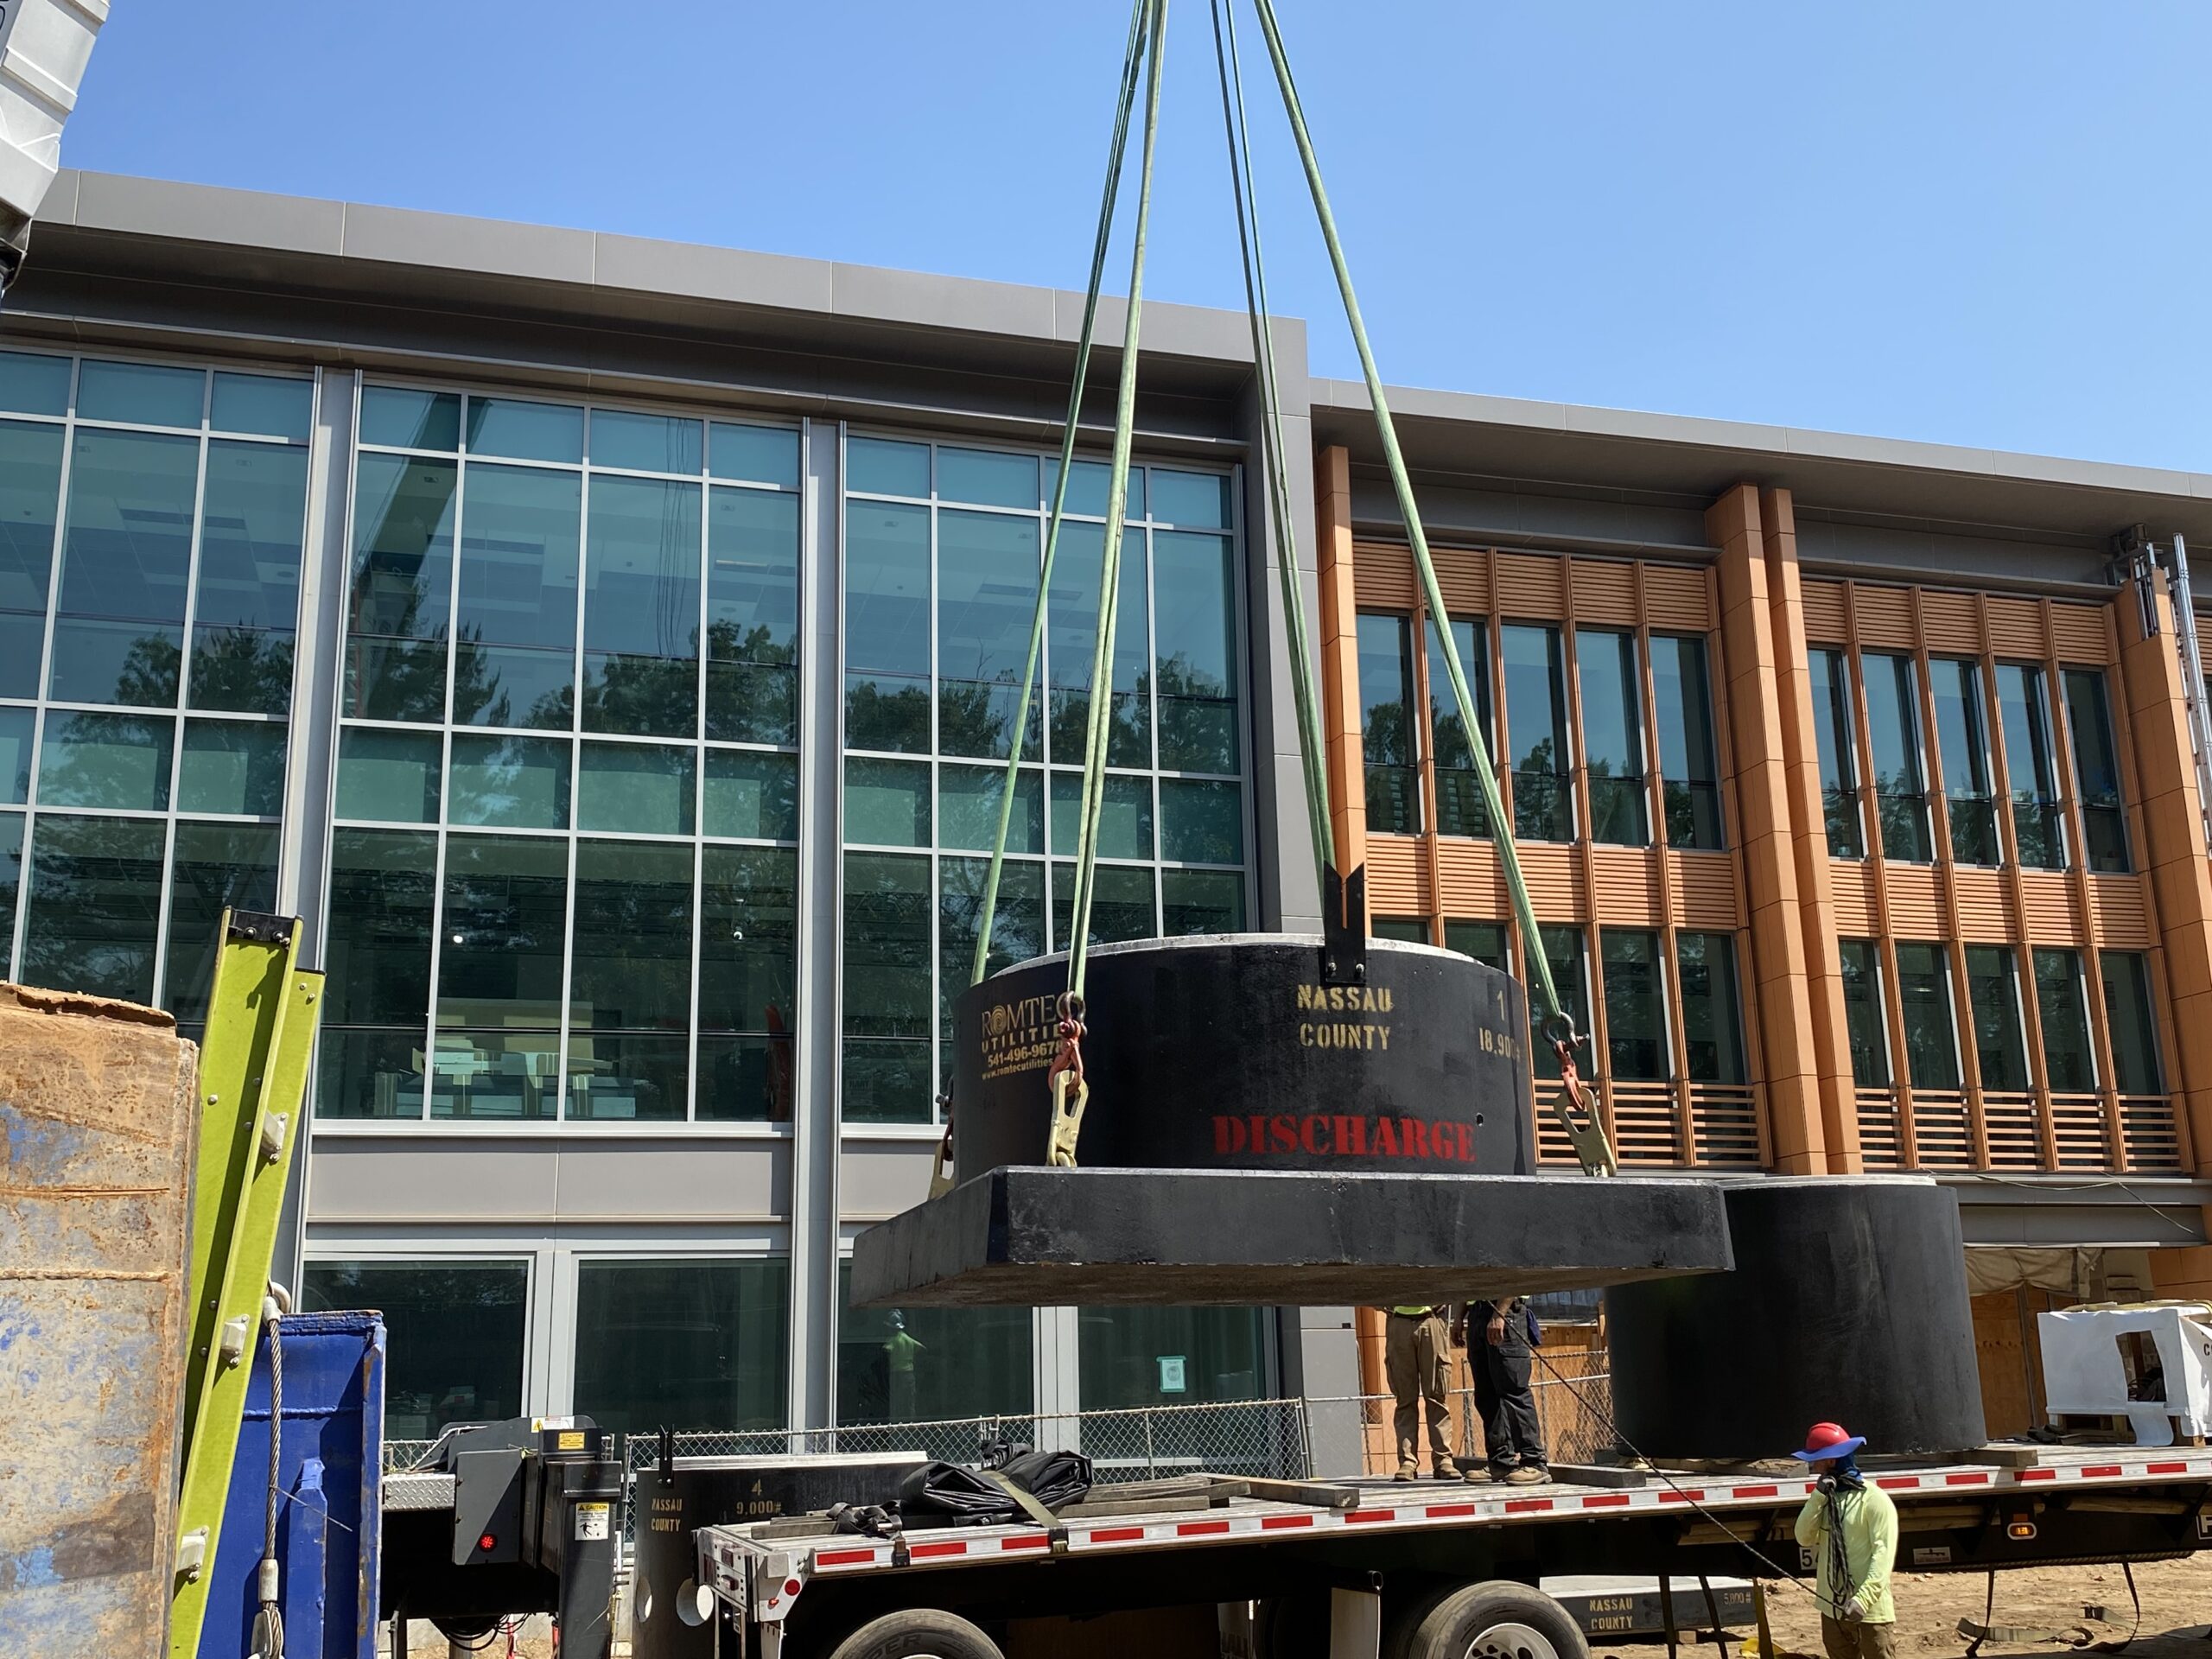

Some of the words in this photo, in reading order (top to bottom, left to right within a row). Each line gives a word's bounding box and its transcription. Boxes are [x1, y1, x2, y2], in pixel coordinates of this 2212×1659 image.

[1297, 984, 1393, 1012] NASSAU
[1497, 990, 1504, 1021] 1
[982, 995, 1057, 1038] ROMTE
[982, 1023, 1062, 1052] UTILITIE
[1300, 1022, 1391, 1051] COUNTY
[1211, 1114, 1477, 1162] DISCHARGE
[751, 1478, 762, 1496] 4
[652, 1498, 683, 1512] NASSAU
[652, 1517, 681, 1532] COUNTY
[1589, 1598, 1633, 1611] NASSAU
[1591, 1616, 1633, 1630] COUNTY
